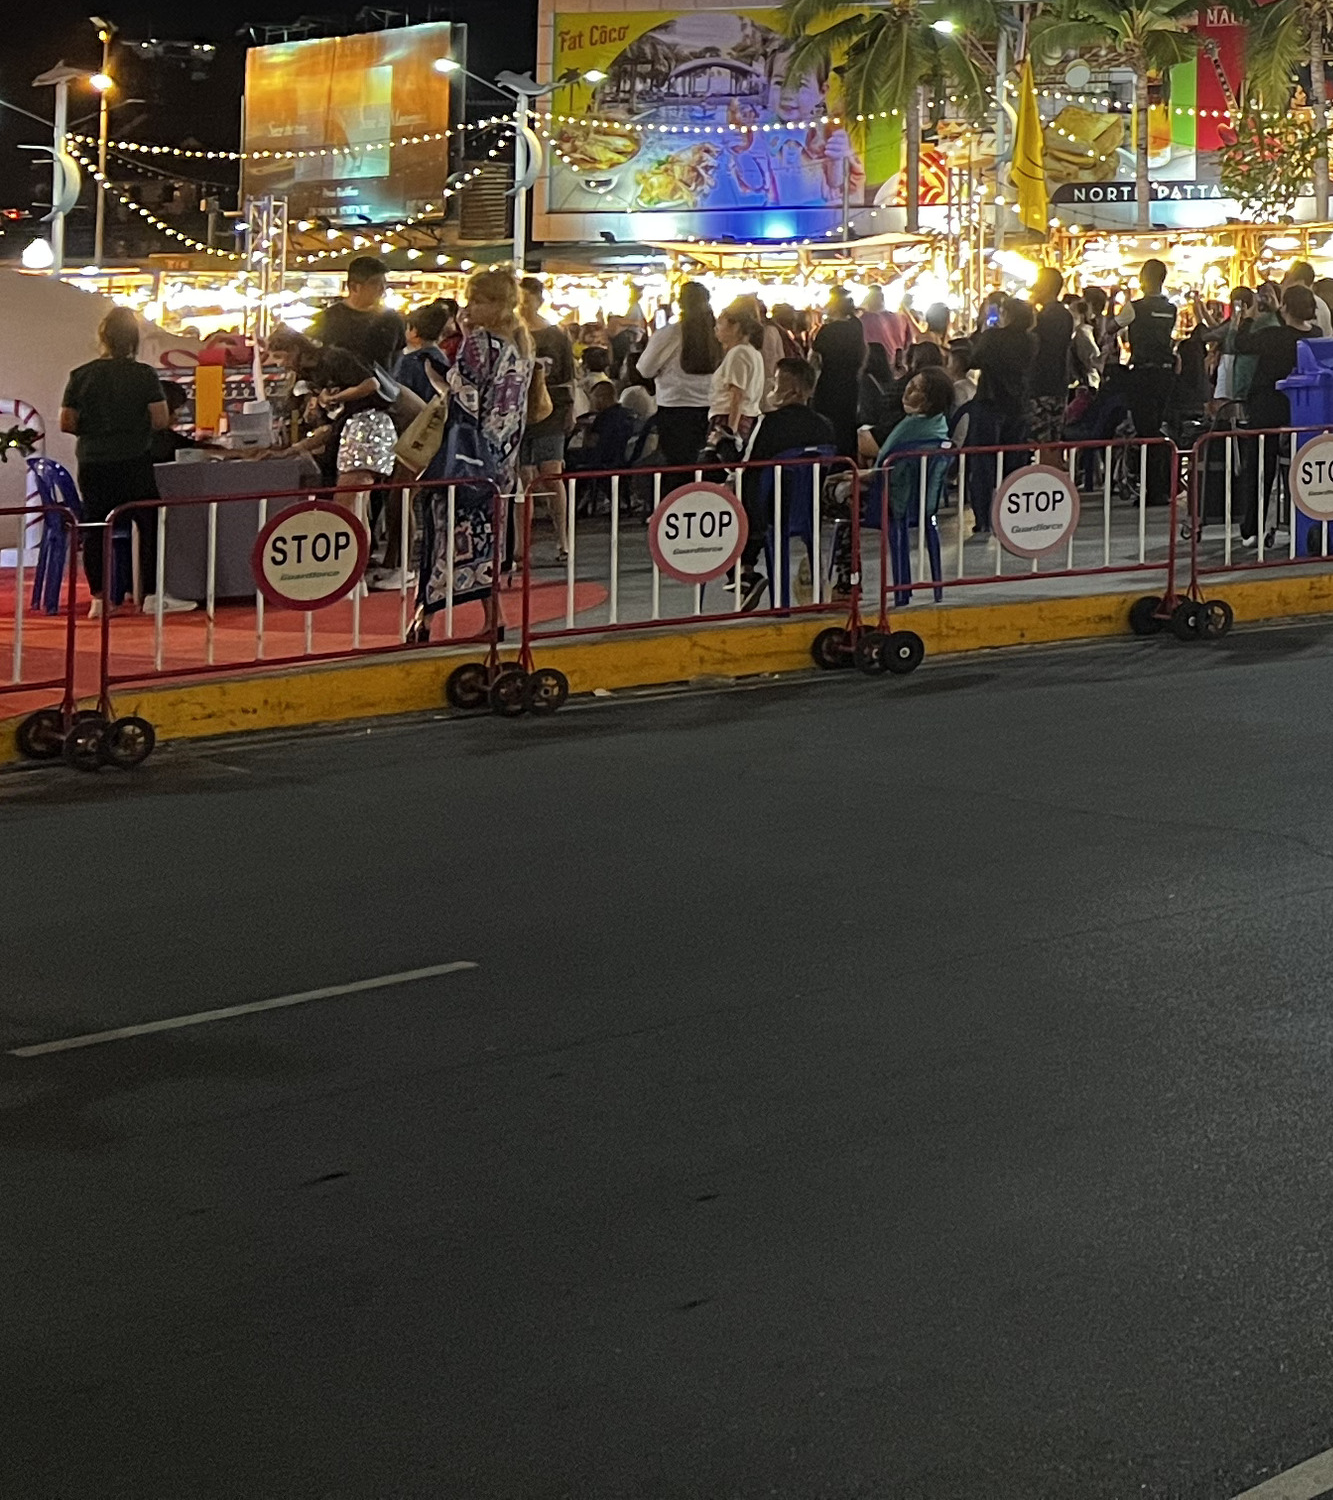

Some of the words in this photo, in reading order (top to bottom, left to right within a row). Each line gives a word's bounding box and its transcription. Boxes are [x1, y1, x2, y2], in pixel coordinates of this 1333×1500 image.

[558, 30, 584, 52] Fat
[1157, 184, 1223, 200] PATTA
[1008, 490, 1065, 514] STOP
[665, 510, 732, 540] STOP
[271, 531, 350, 566] STOP
